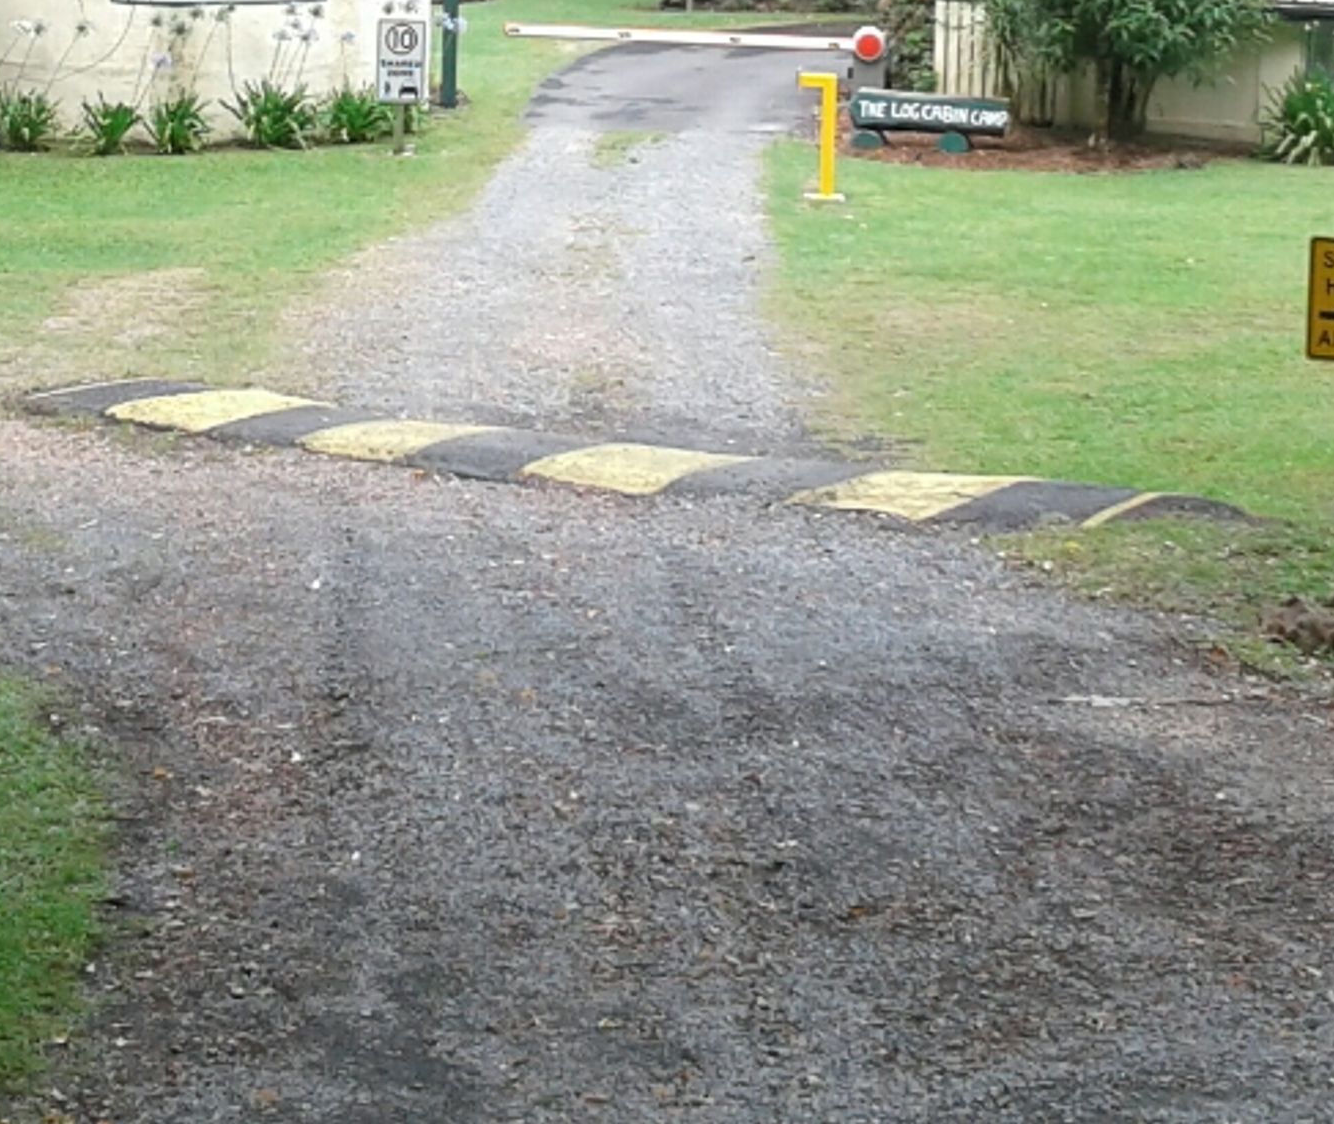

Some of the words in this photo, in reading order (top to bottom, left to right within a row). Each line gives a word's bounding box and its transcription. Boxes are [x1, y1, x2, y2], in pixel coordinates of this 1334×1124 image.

[392, 28, 413, 49] 10
[858, 99, 887, 119] THE
[890, 102, 921, 121] LOG
[921, 104, 969, 124] CABIN
[970, 109, 1008, 127] CAMP
